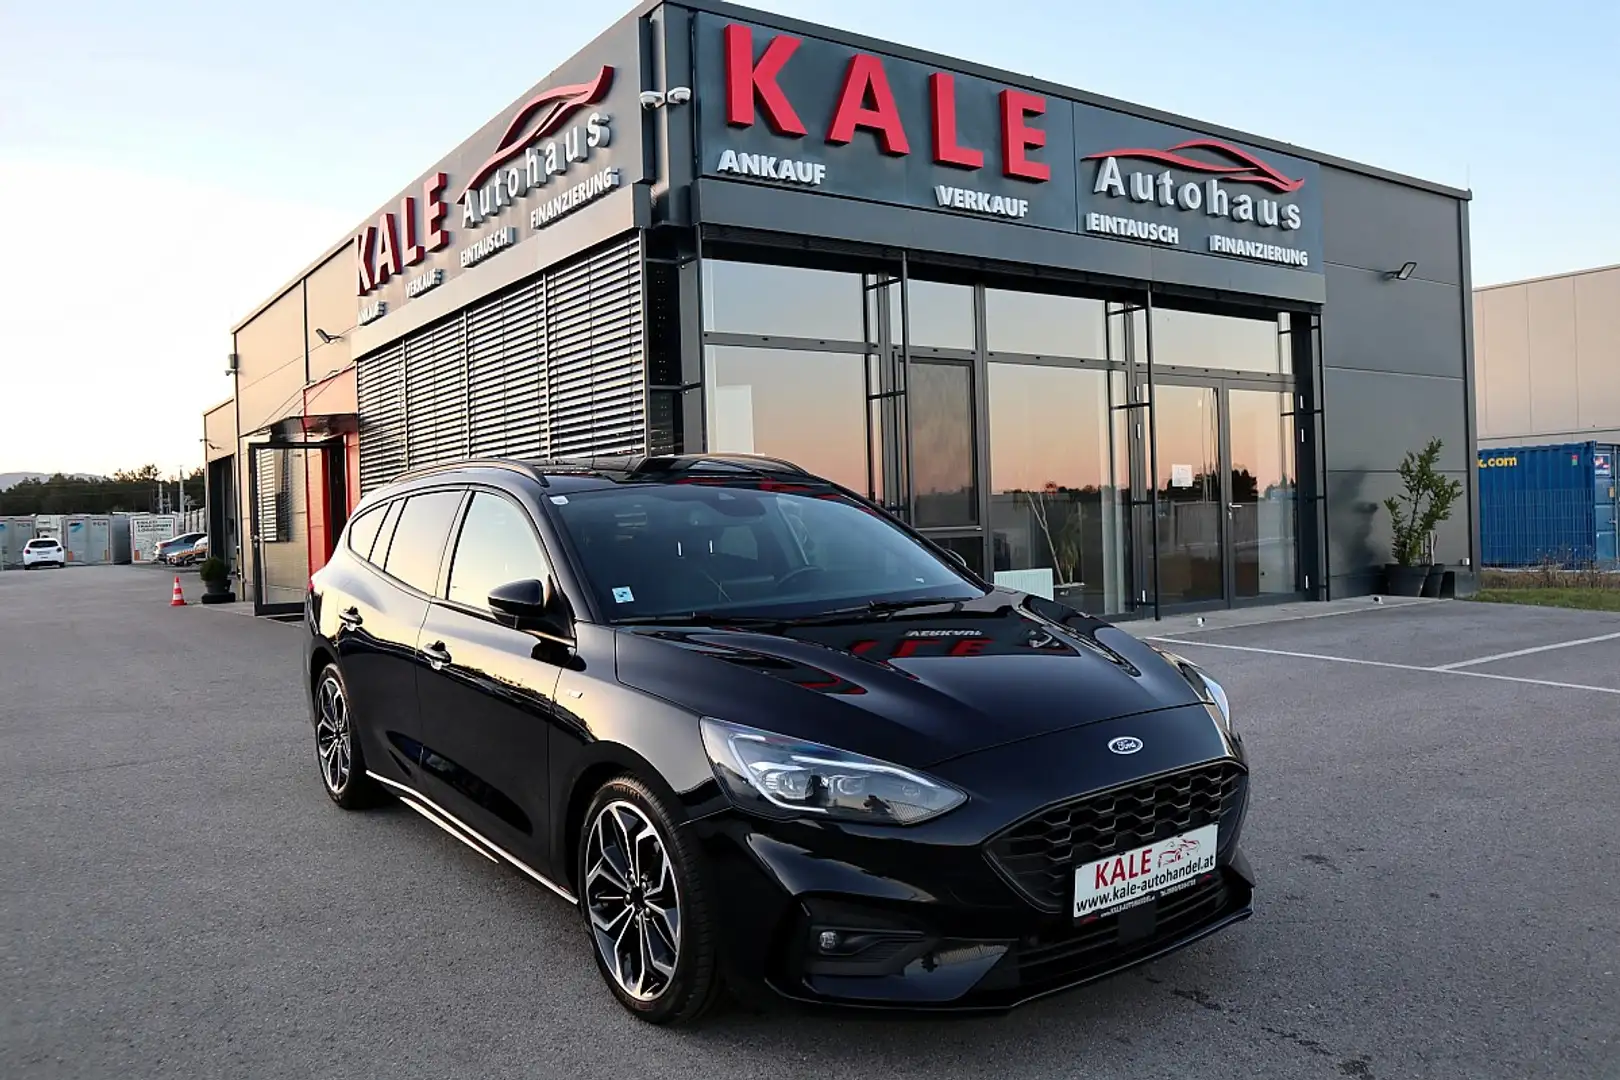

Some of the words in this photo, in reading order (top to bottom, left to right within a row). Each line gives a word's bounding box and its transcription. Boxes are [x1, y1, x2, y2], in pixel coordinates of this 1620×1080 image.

[724, 23, 1051, 183] KALE
[461, 112, 611, 228] Autohaus
[717, 150, 826, 186] ANKAUF
[530, 167, 620, 230] FINANZIERUNG
[935, 186, 1029, 219] VERKAUF
[1094, 156, 1302, 231] Autohaus
[354, 172, 449, 296] KALE
[460, 227, 516, 268] EINTAUSCH
[1086, 213, 1180, 246] EINTAUSCH
[1209, 235, 1309, 268] FINANZIERUNG
[1076, 854, 1214, 913] www.kale-autohandel.at
[1094, 848, 1153, 890] KALE
